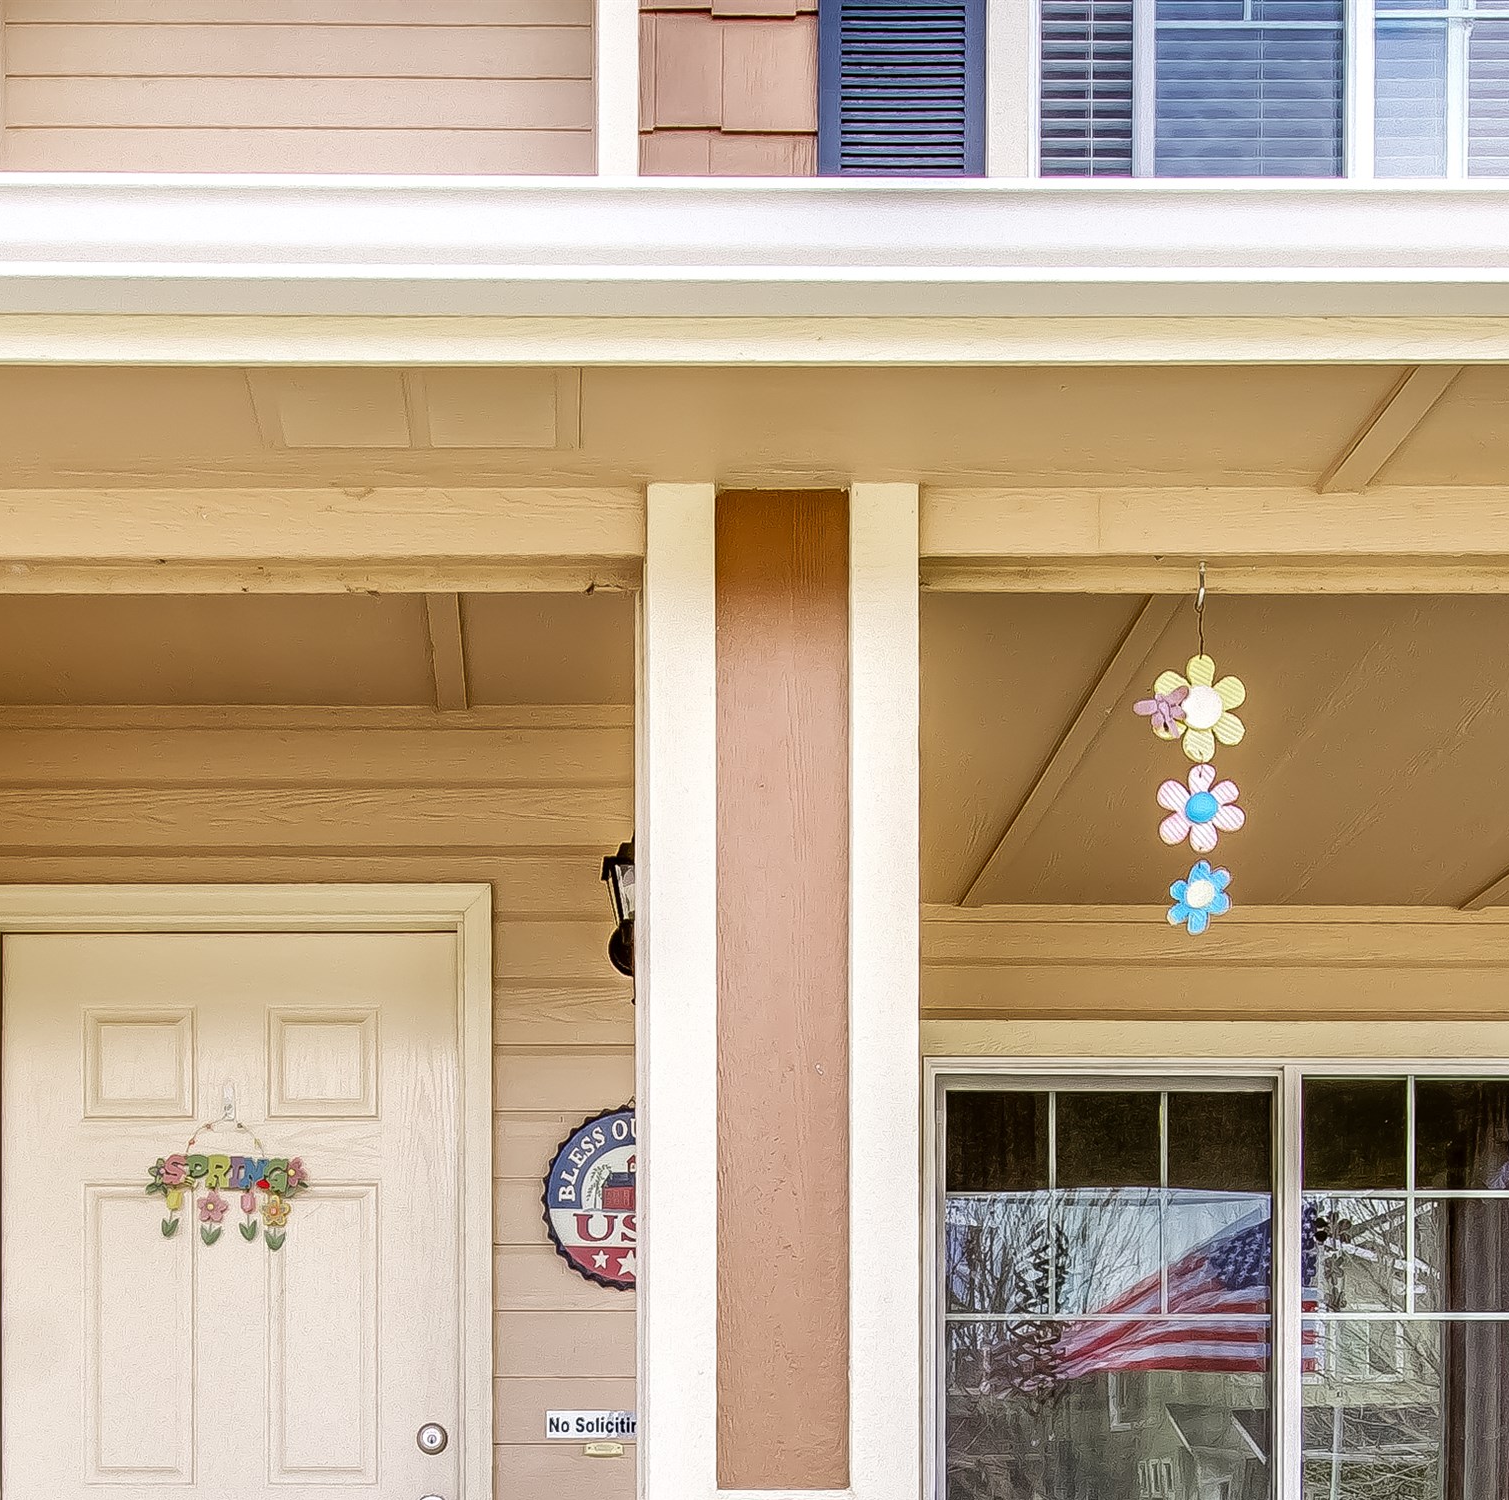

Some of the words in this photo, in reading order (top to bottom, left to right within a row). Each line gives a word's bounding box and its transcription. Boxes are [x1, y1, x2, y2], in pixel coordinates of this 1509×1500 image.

[162, 1154, 289, 1193] SPRING
[558, 1126, 606, 1202] BLESS
[549, 1417, 569, 1432] No
[575, 1416, 637, 1433] Solicitin
